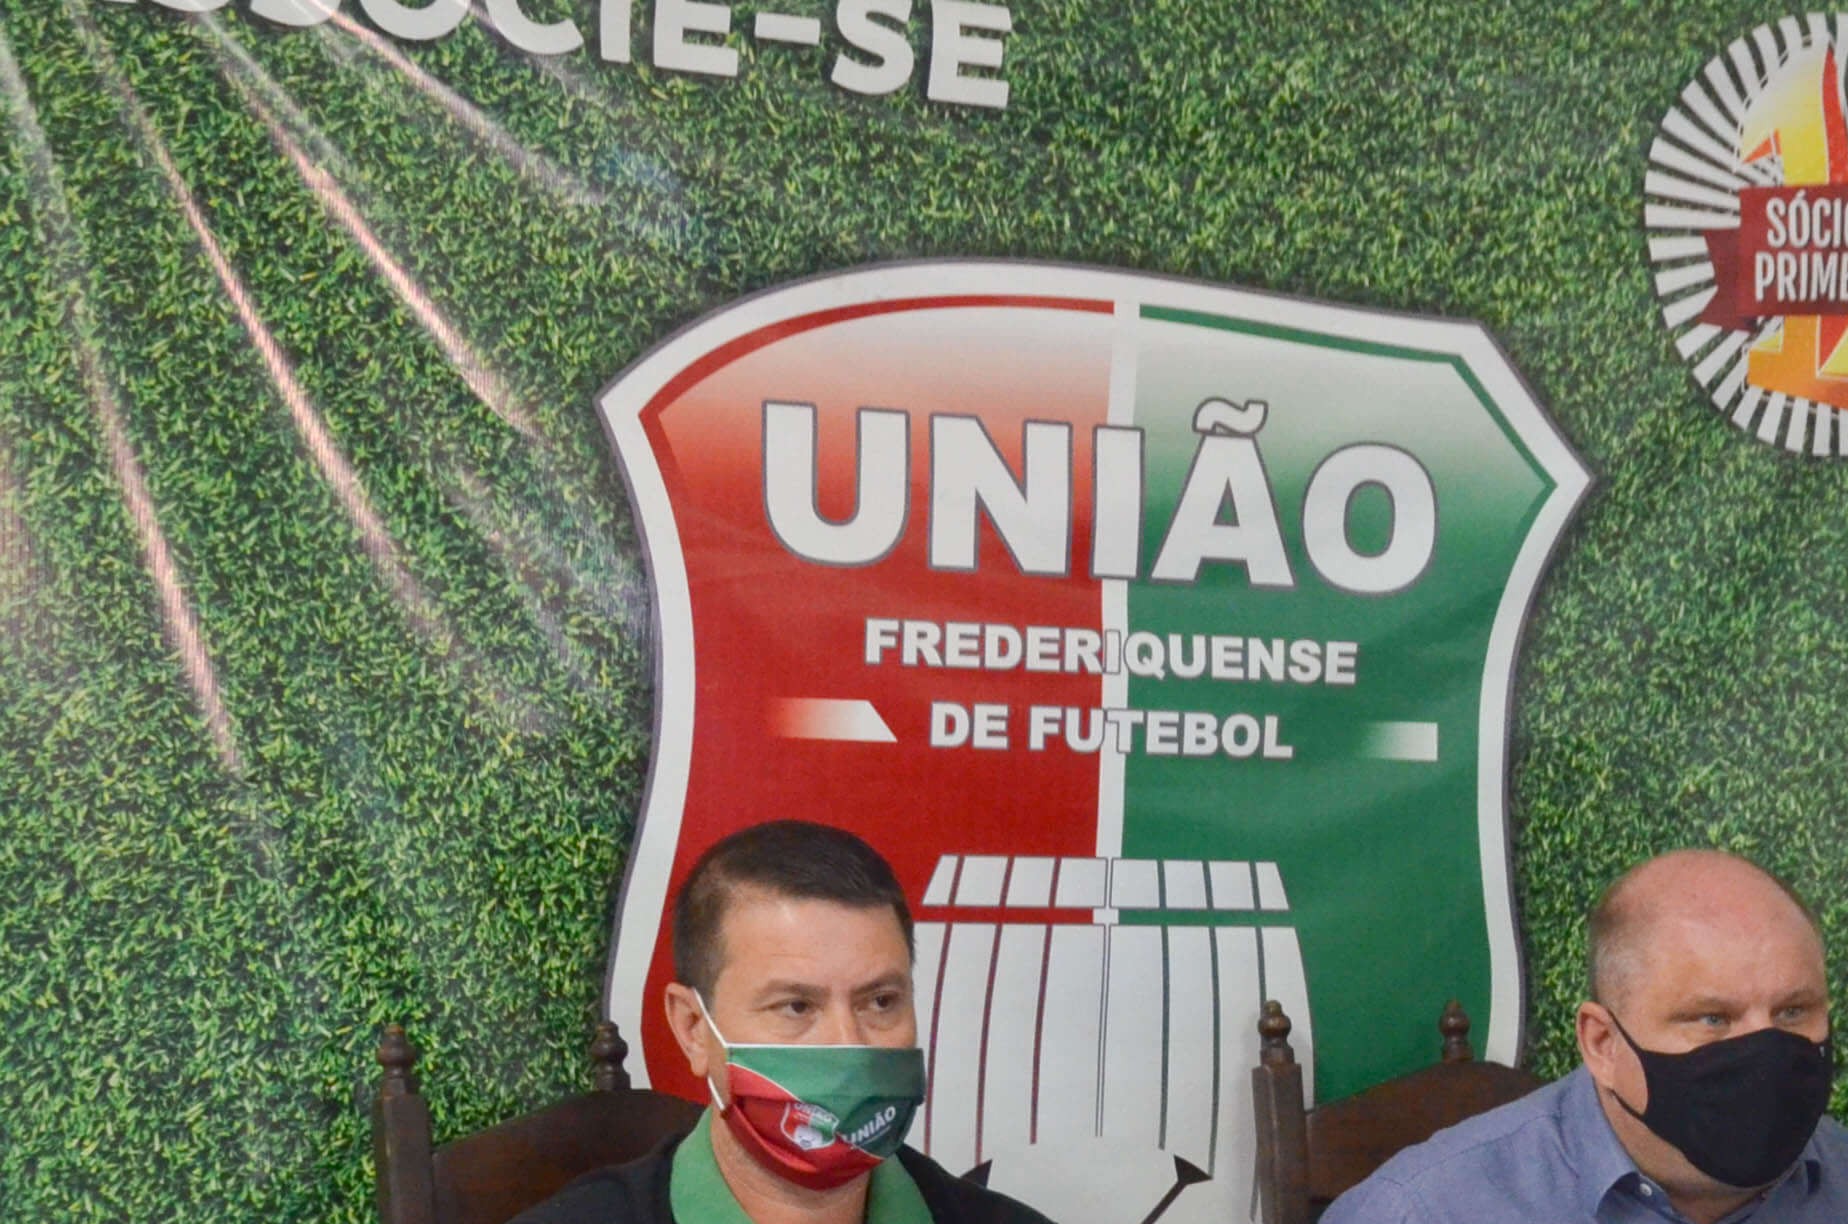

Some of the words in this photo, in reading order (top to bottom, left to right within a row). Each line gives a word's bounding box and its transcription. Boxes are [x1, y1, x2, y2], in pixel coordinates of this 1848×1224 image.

[105, 0, 1012, 107] CIE-SE
[762, 397, 1438, 597] UNIÃO
[864, 617, 1358, 685] FREDERIQUENSE
[929, 700, 1010, 750] DE
[1027, 705, 1295, 759] FUTEBOL
